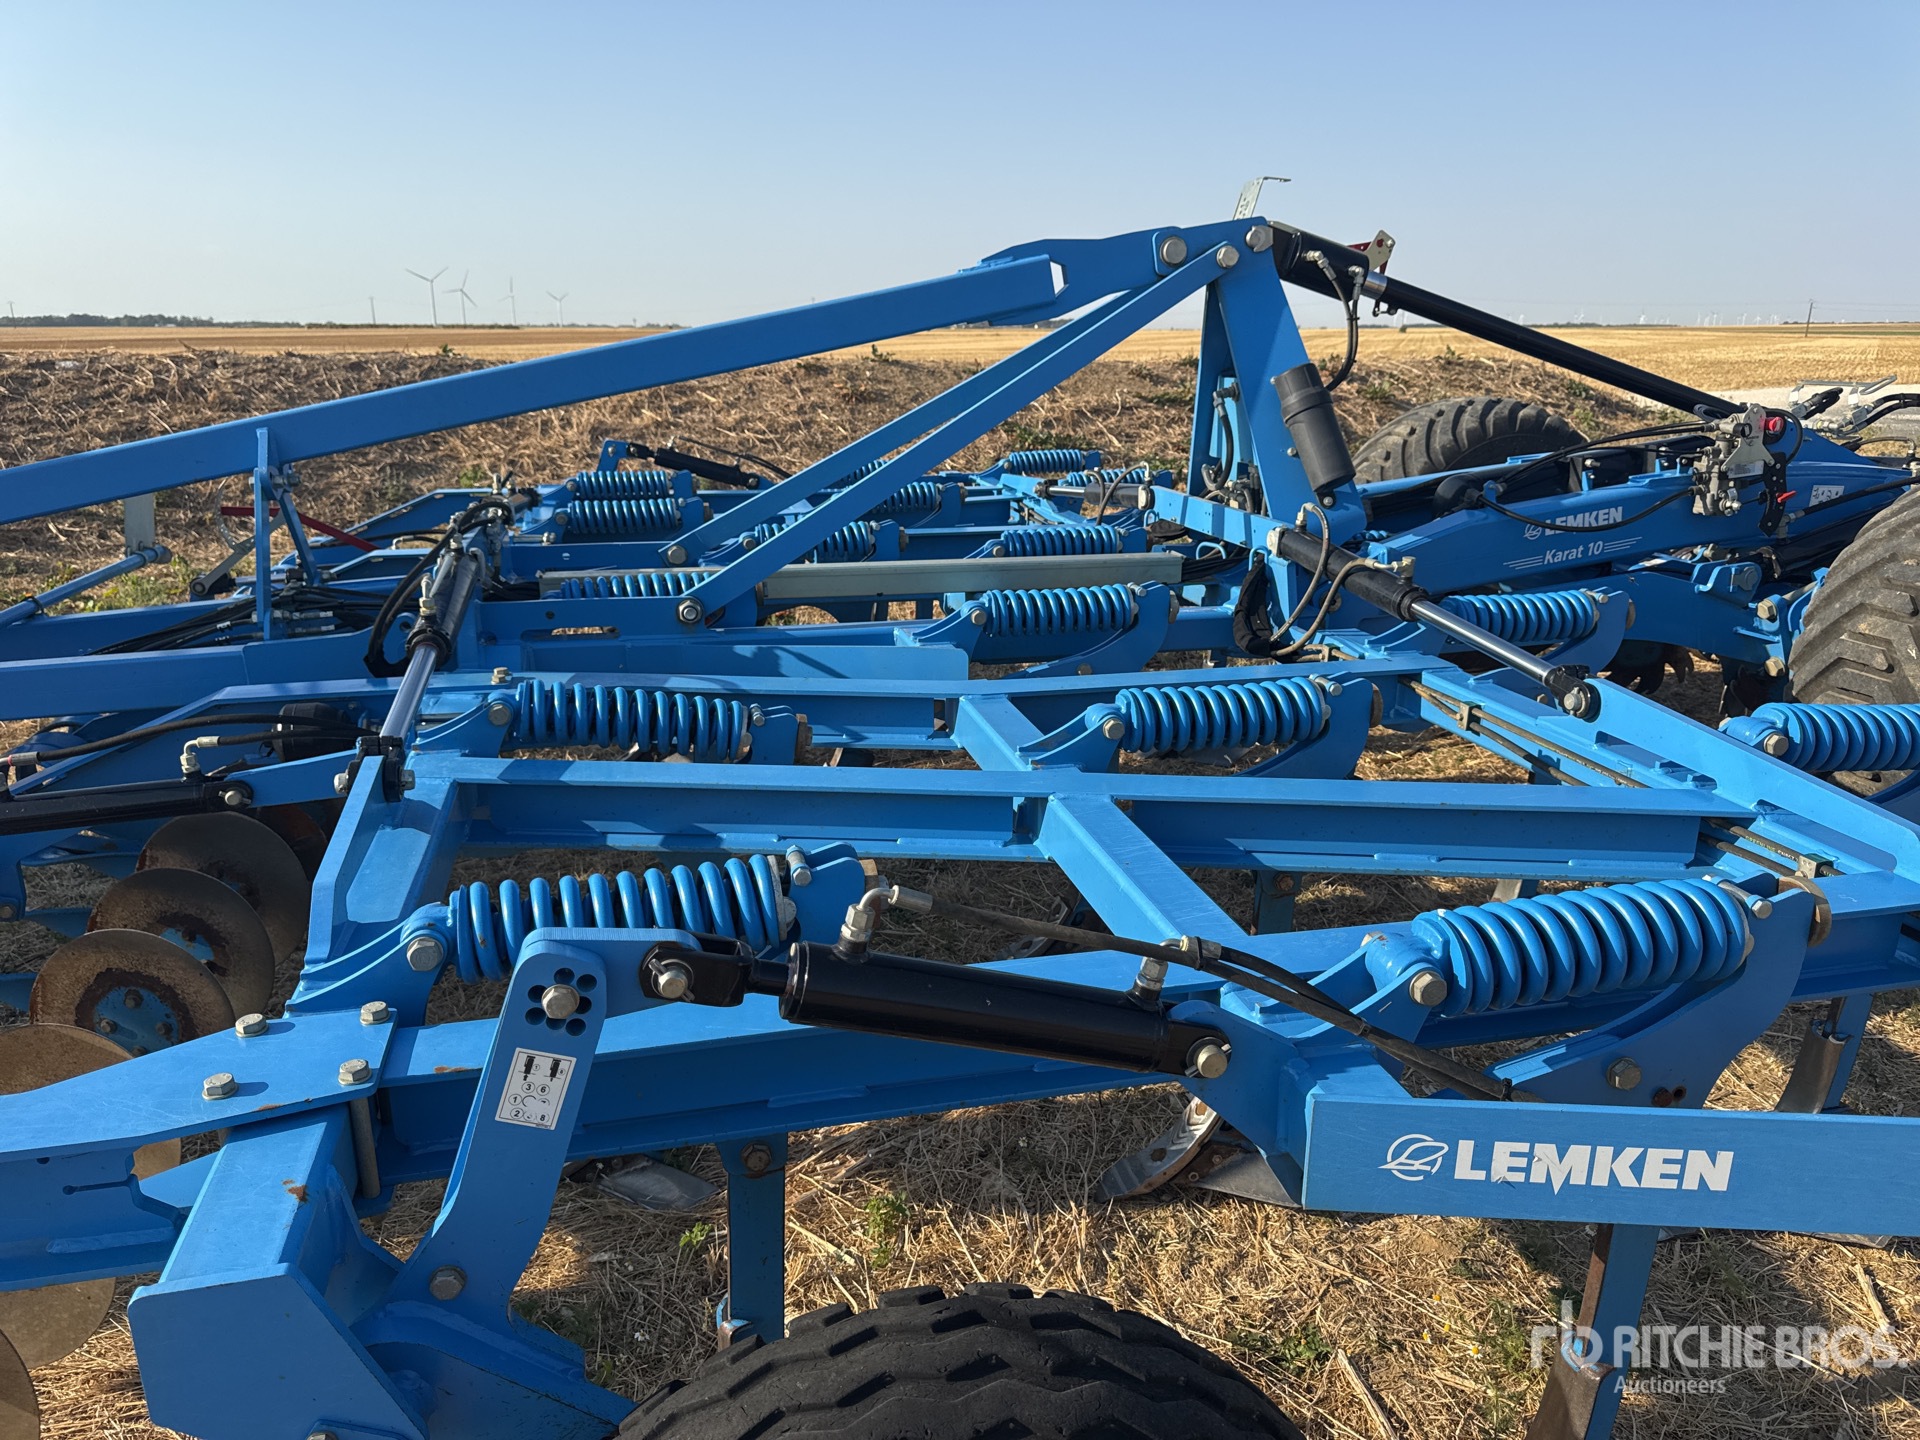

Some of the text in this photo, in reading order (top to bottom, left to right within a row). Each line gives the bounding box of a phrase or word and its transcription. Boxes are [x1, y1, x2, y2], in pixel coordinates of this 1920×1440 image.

[1544, 506, 1623, 536] LEMKEN
[1544, 541, 1603, 565] Karat 10
[525, 1083, 532, 1091] 3
[513, 1110, 546, 1122] 2 8
[1454, 1140, 1734, 1195] LEMKEN
